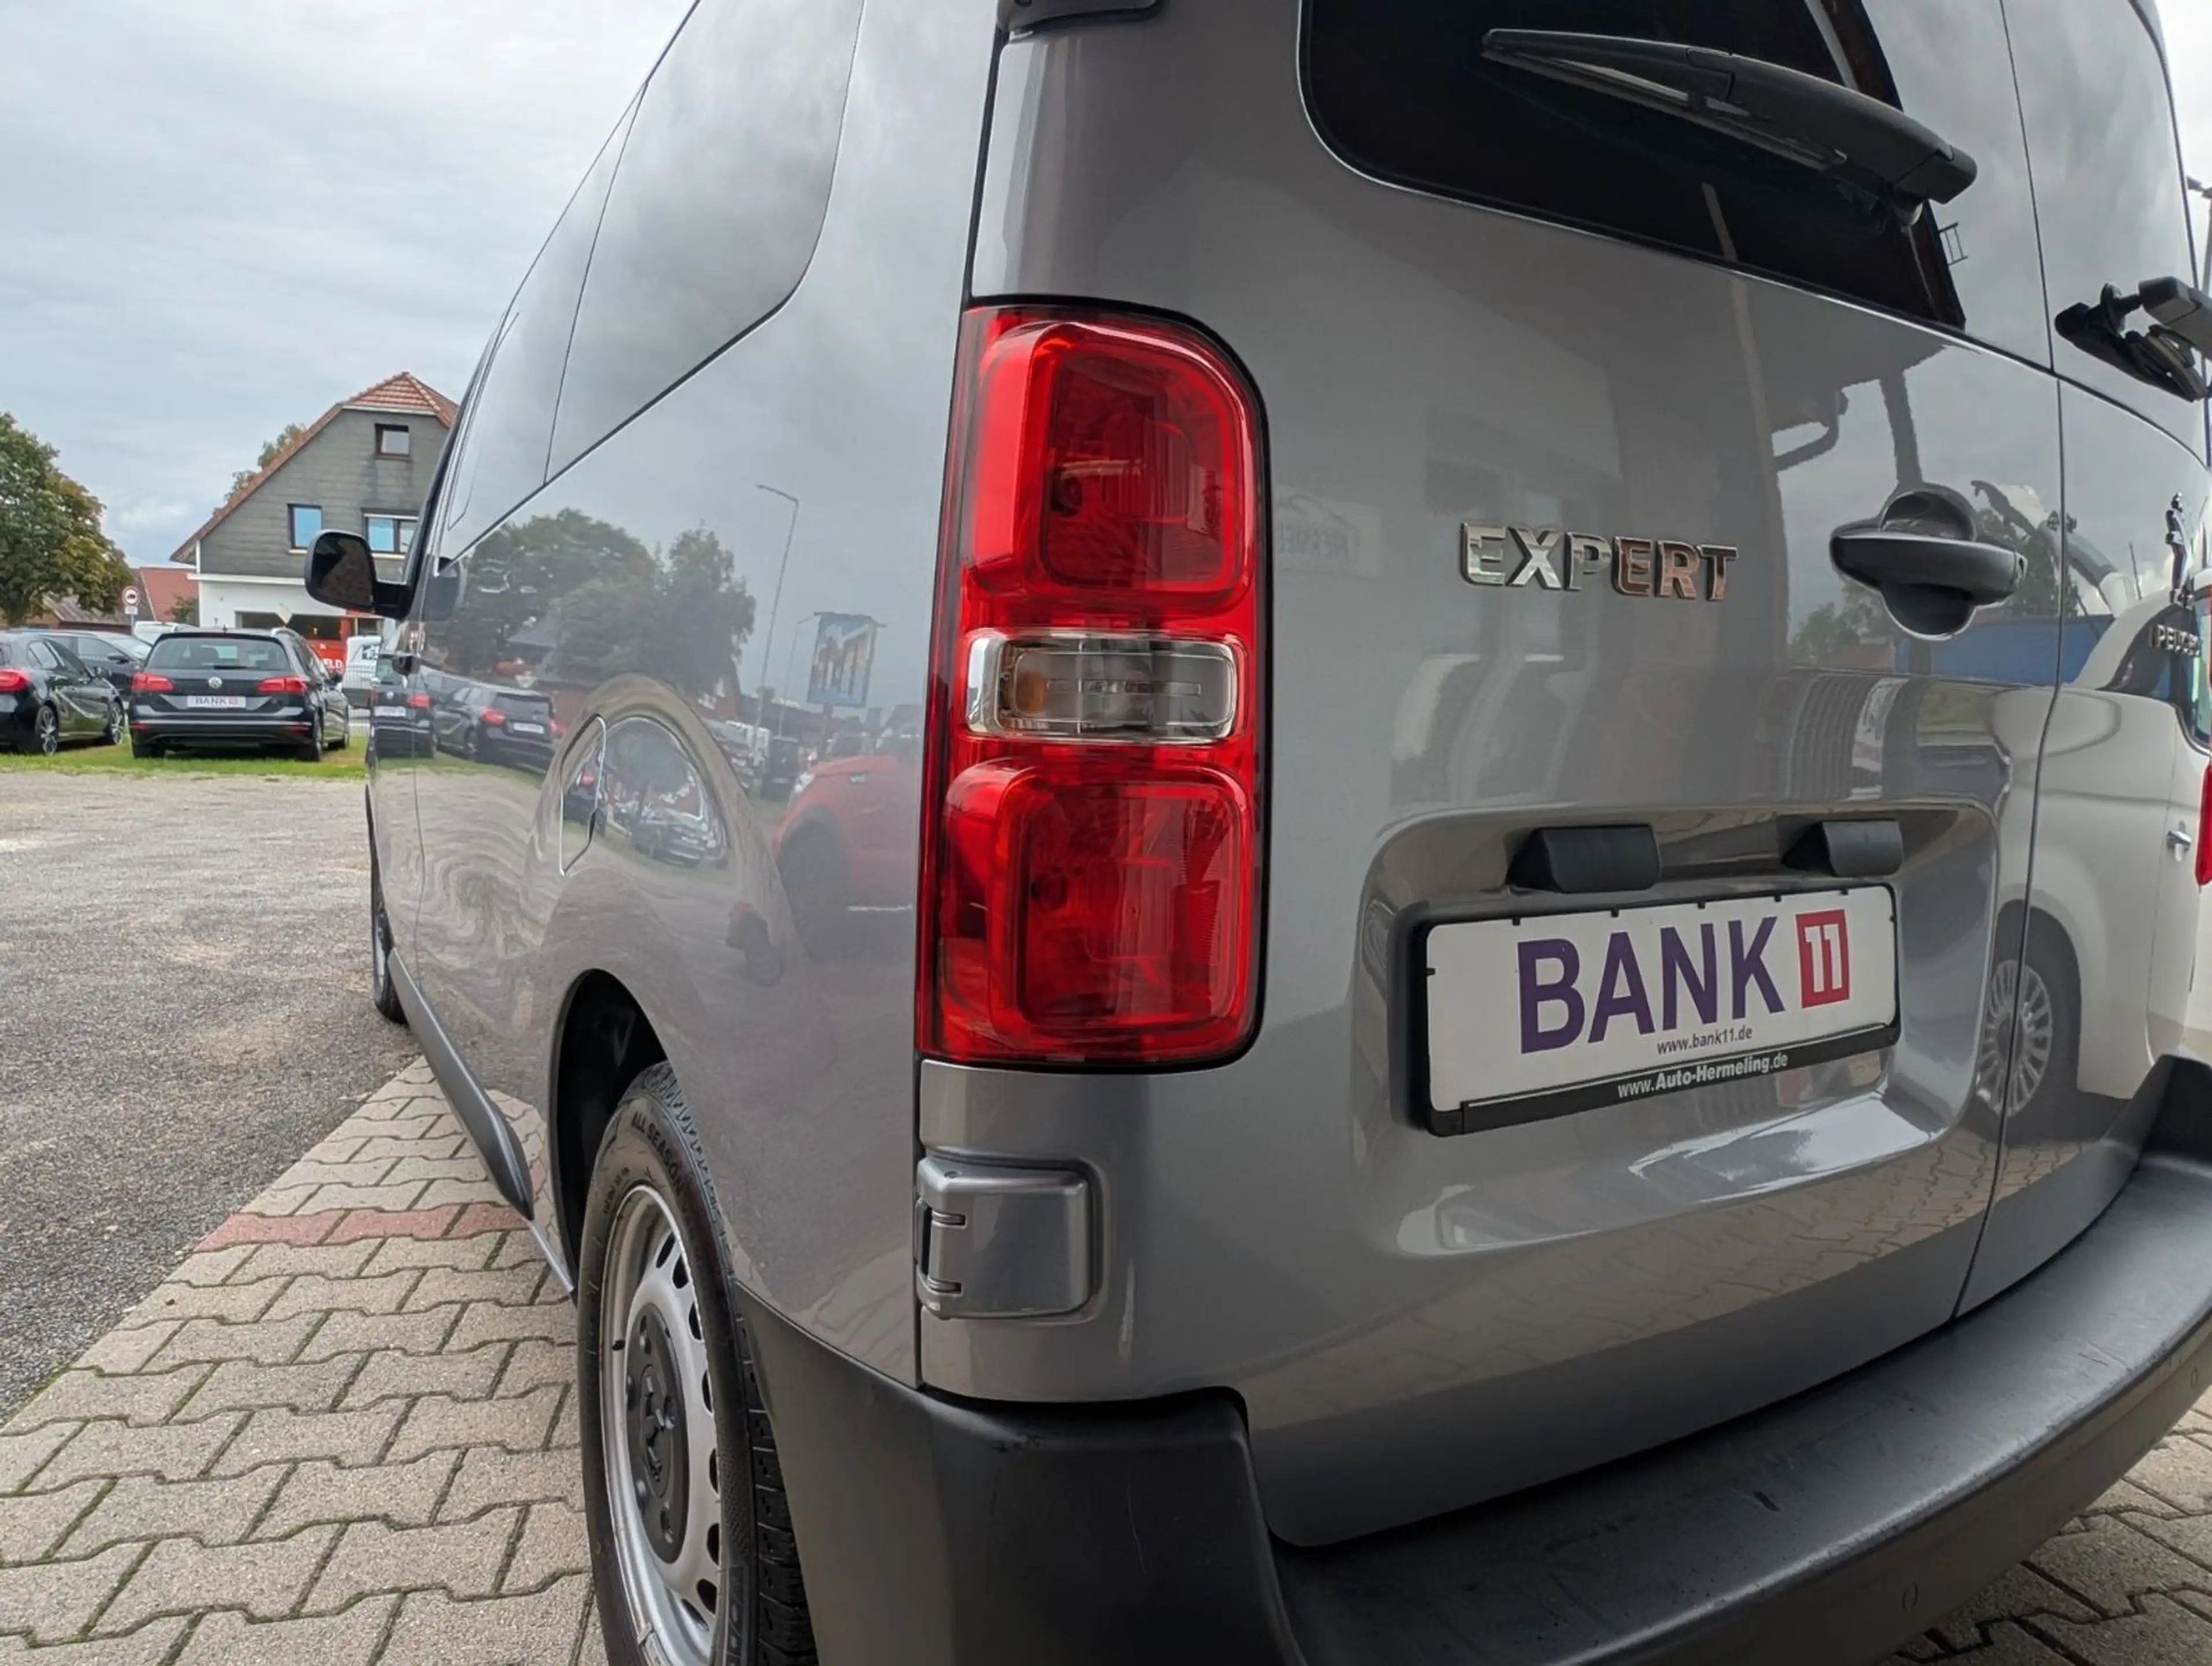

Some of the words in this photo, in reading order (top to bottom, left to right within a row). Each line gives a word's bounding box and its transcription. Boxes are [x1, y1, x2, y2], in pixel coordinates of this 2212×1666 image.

[1460, 522, 1738, 600] EXPERT
[1517, 916, 1784, 1055] BANK
[1801, 916, 1847, 1001] 11
[1657, 1025, 1753, 1055] www.bank11.de
[1617, 1052, 1788, 1099] www.Auto-Hermeling.de
